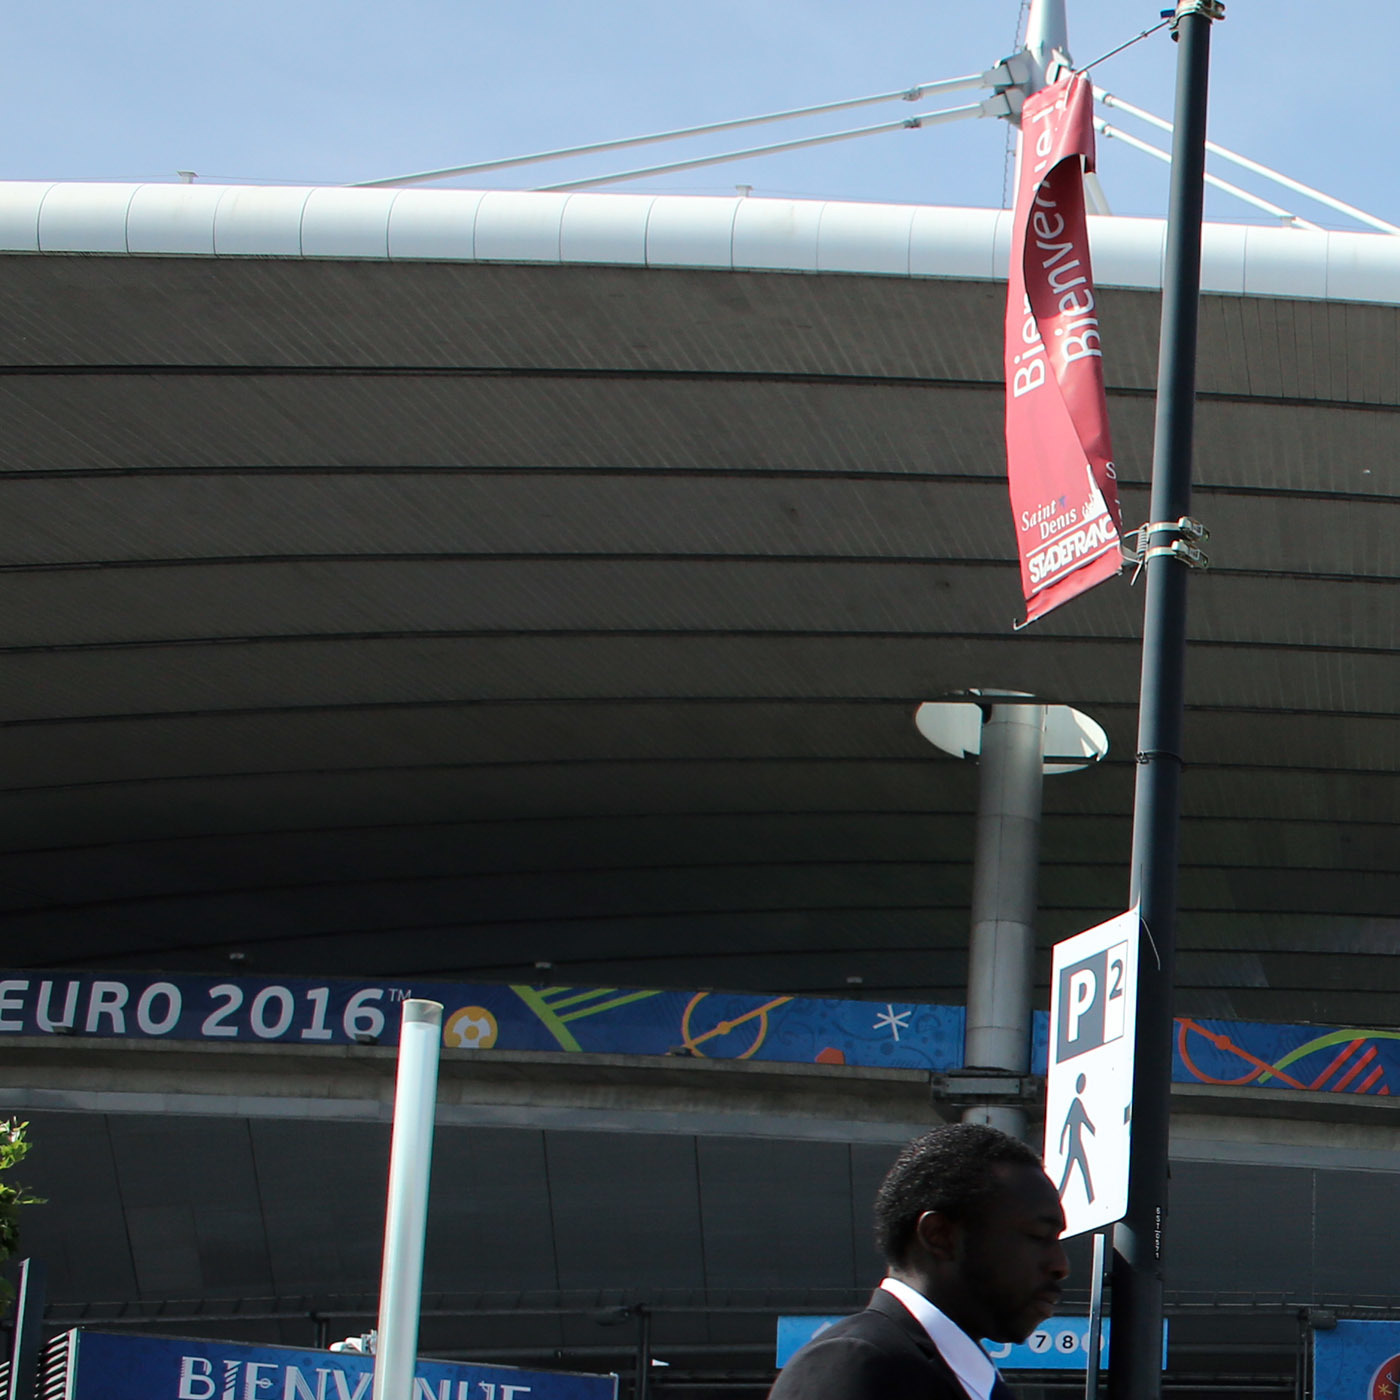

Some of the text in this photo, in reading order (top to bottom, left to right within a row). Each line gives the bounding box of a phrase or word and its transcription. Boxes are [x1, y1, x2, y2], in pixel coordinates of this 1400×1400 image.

[1021, 500, 1057, 532] Saint
[1040, 508, 1078, 540] Denis
[0, 980, 183, 1035] EURO
[1035, 1335, 1074, 1349] 7 8
